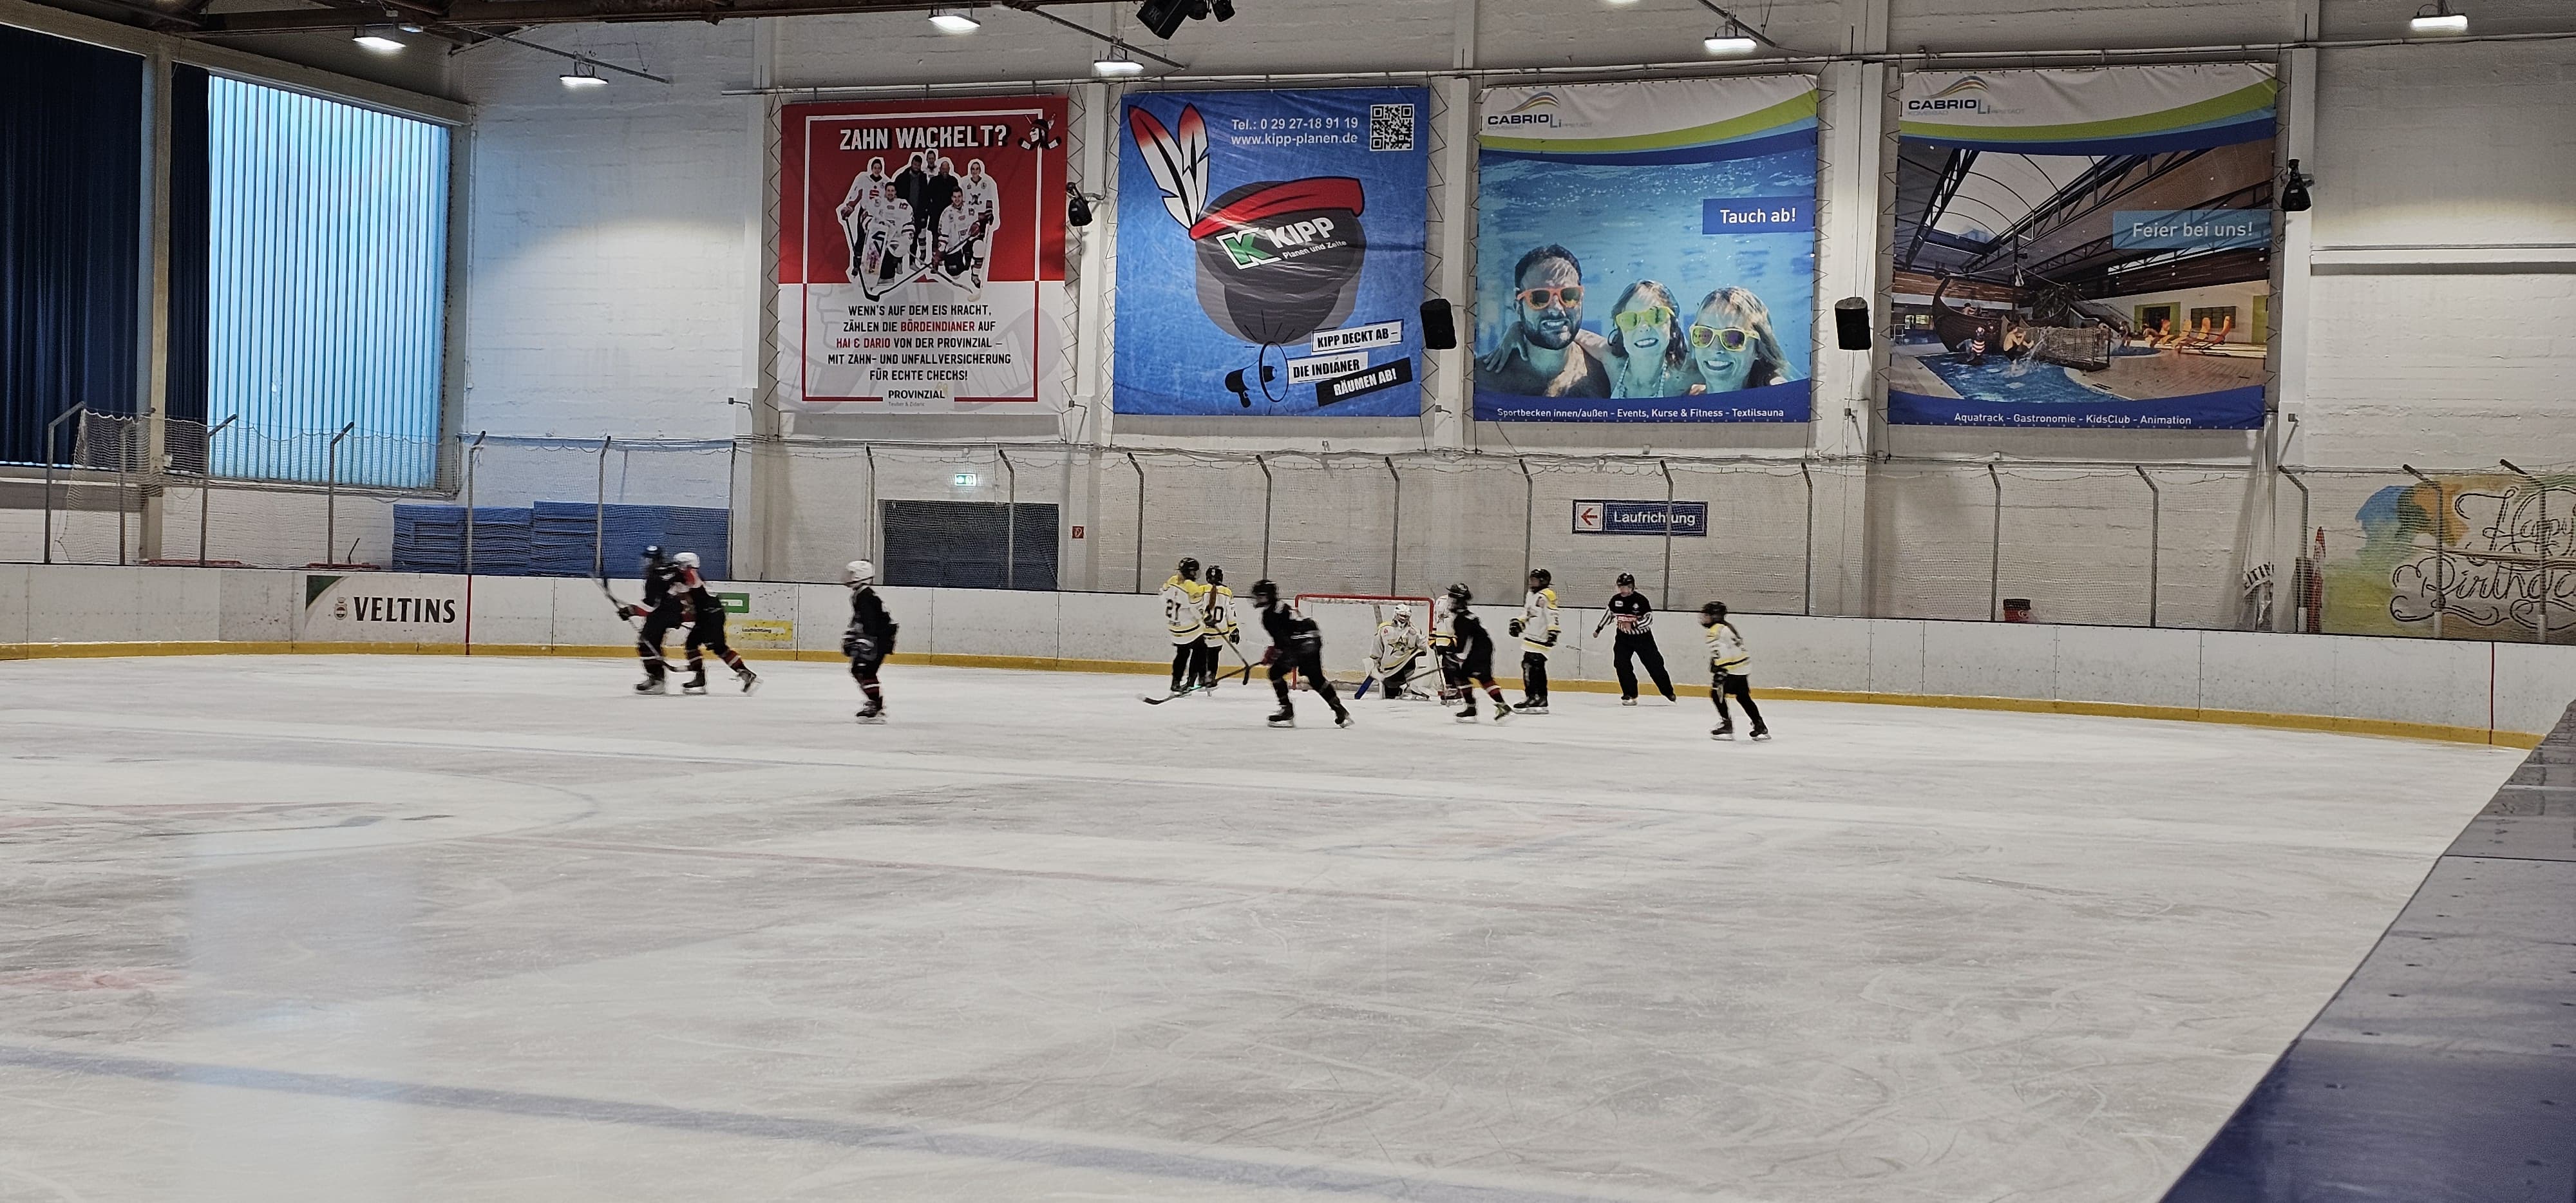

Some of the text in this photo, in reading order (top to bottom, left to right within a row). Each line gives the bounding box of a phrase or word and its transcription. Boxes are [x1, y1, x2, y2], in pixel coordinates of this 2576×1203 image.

[1231, 117, 1358, 129] Tel.: 0 29 27-18 91 19
[840, 125, 1007, 150] ZAHN WACKELT?
[1231, 132, 1358, 147] www.kipp-planen.de
[1719, 207, 1796, 224] Tauch ab!
[1265, 217, 1334, 249] KIPP
[2133, 222, 2253, 237] Feier bei uns!
[1282, 248, 1310, 260] Planen
[1311, 244, 1326, 253] und
[848, 305, 992, 316] WENN'S AUF DEM EIS KRACHT,
[843, 319, 996, 332] ZÄHLEN DIE BÖRDEINDIANER AUF
[837, 338, 850, 348] HAI
[853, 338, 860, 348] &
[864, 338, 891, 348] DARIO
[894, 338, 913, 348] VON
[915, 338, 934, 348] DER
[938, 337, 992, 348] PROVINZIAL
[1317, 336, 1340, 348] KIPP
[1342, 330, 1373, 345] DECKT
[1376, 328, 1389, 341] AB
[828, 354, 1011, 365] MIT ZAHN- UND UNFALLVERSICHERUNG
[869, 368, 968, 381] FÜR ECHTE CHECKS!
[1293, 359, 1360, 379] DIE INDIANER
[1333, 368, 1397, 396] RÄUMEN AB!
[888, 390, 945, 399] PROVINZIAL
[1497, 408, 1551, 417] Sportbecken
[1553, 408, 1608, 417] innen/außen
[1617, 408, 1649, 418] Events,
[1651, 408, 1678, 417] Kurse
[1680, 409, 1687, 417] &
[1690, 408, 1723, 417] Fitness
[1732, 408, 1784, 417] Textilsauna
[1955, 413, 2004, 422] Aquatrack
[2013, 413, 2076, 423] Gastronomie
[2086, 414, 2130, 424] KidsClub
[2140, 415, 2192, 425] Animation
[1614, 511, 1696, 526] Laufrichung
[354, 596, 456, 623] VELTINS
